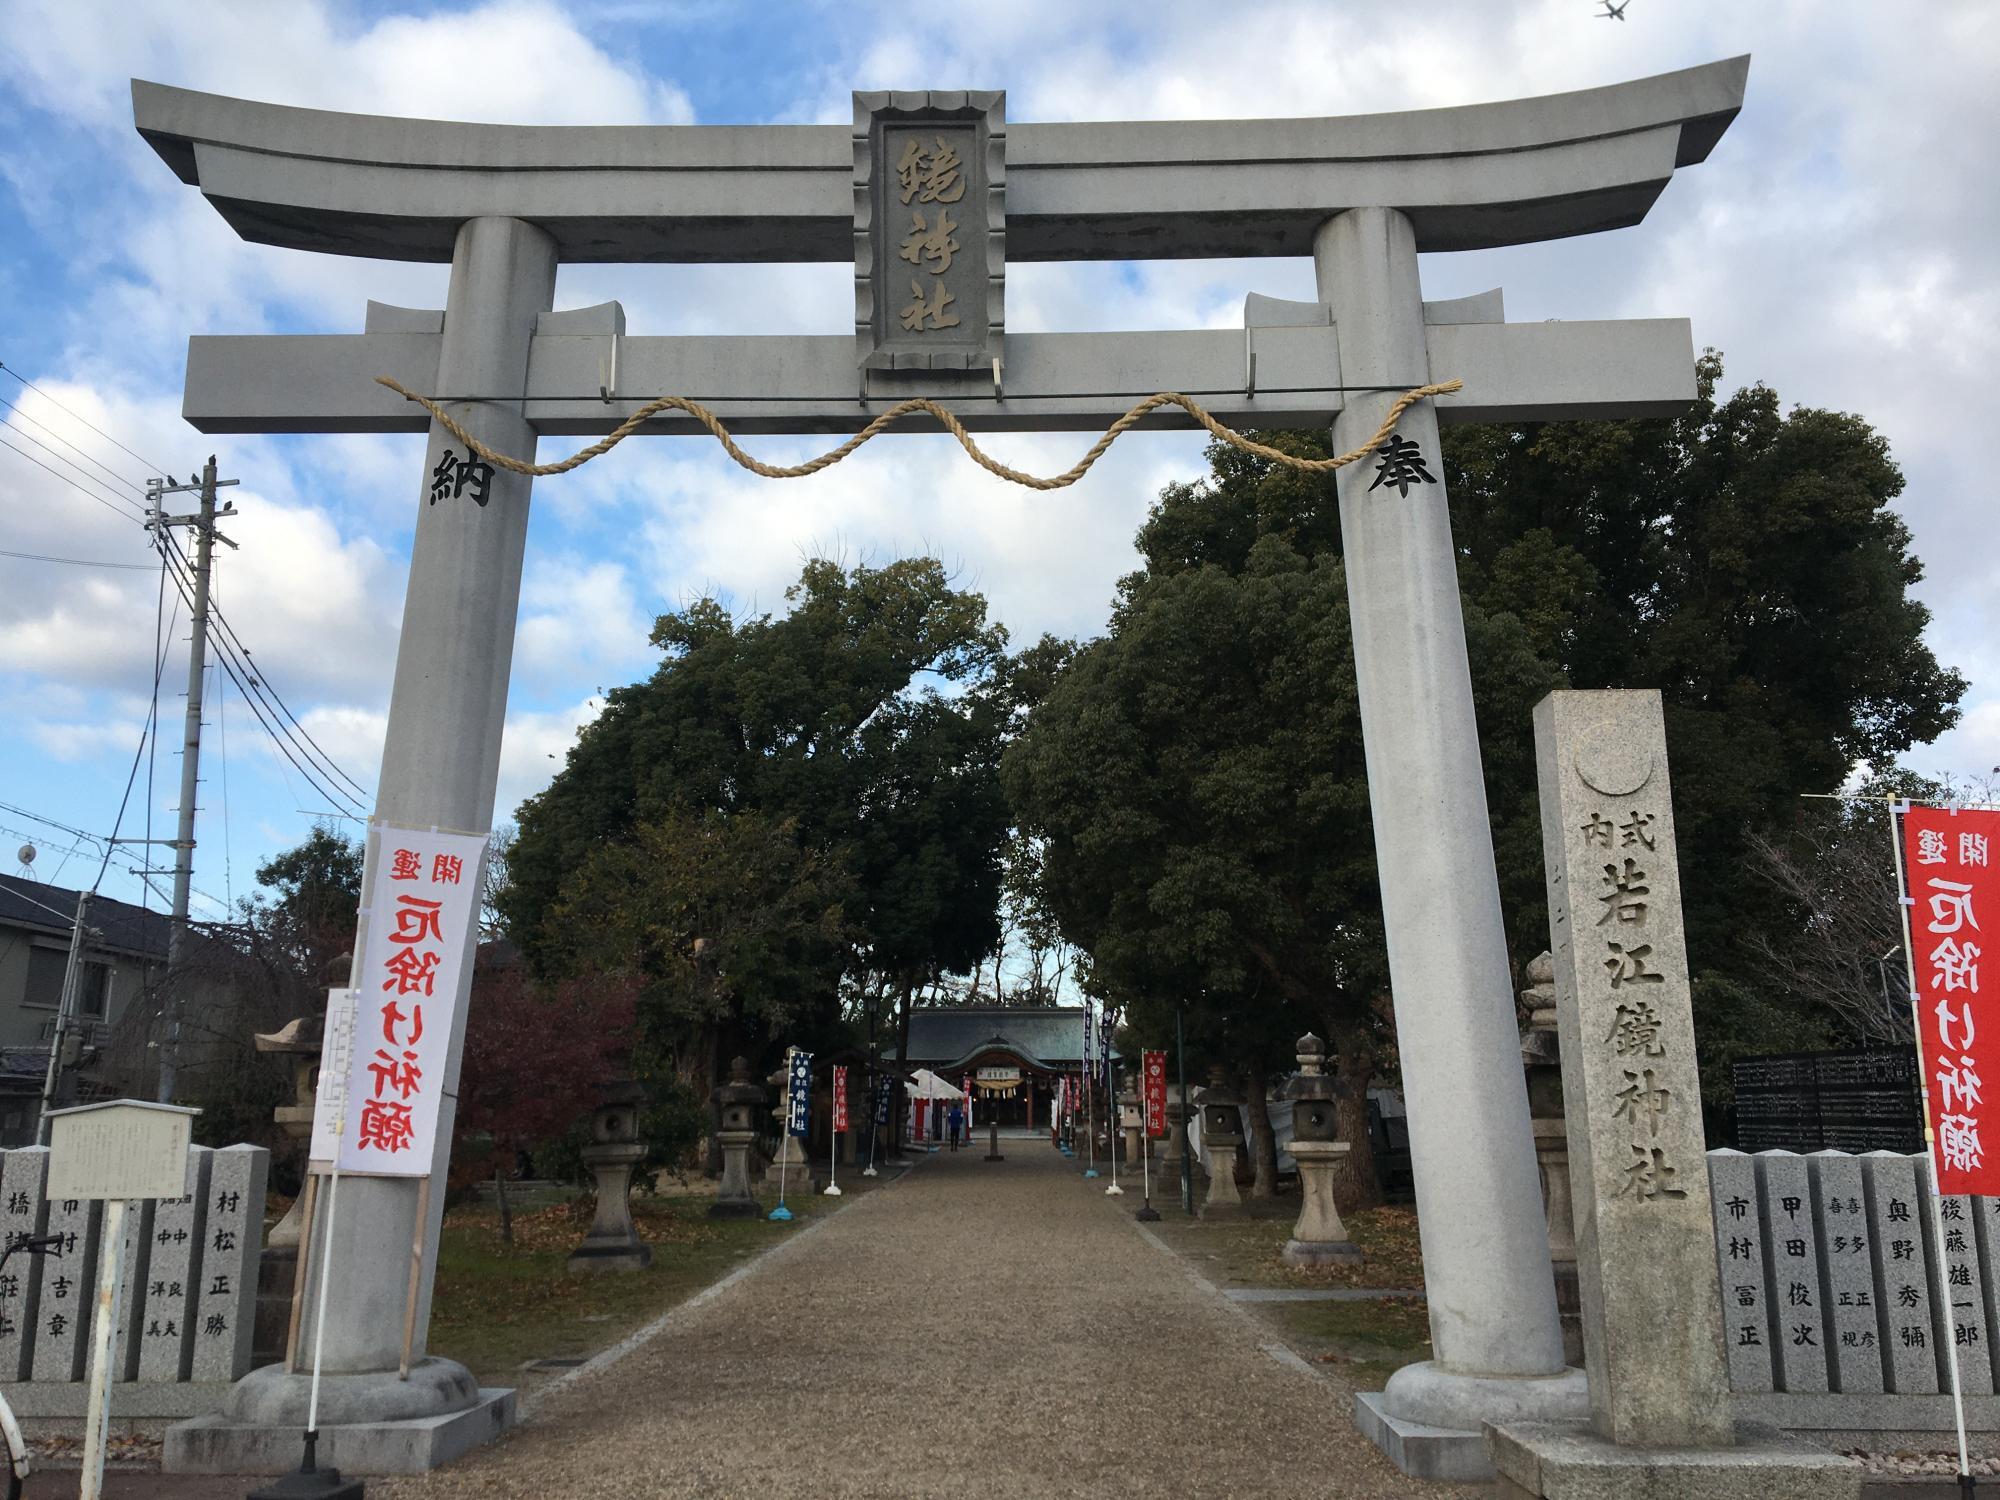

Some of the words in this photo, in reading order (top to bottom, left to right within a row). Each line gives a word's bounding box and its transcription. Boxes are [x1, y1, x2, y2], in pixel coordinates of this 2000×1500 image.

[430, 444, 496, 507] 納
[1368, 434, 1438, 499] 奉
[1595, 856, 1688, 1206] 若江鏡神社
[203, 1190, 241, 1337] 村松正勝
[1781, 1196, 1820, 1347] 甲田俊次
[1940, 1198, 1979, 1348] 後藤雄一郎
